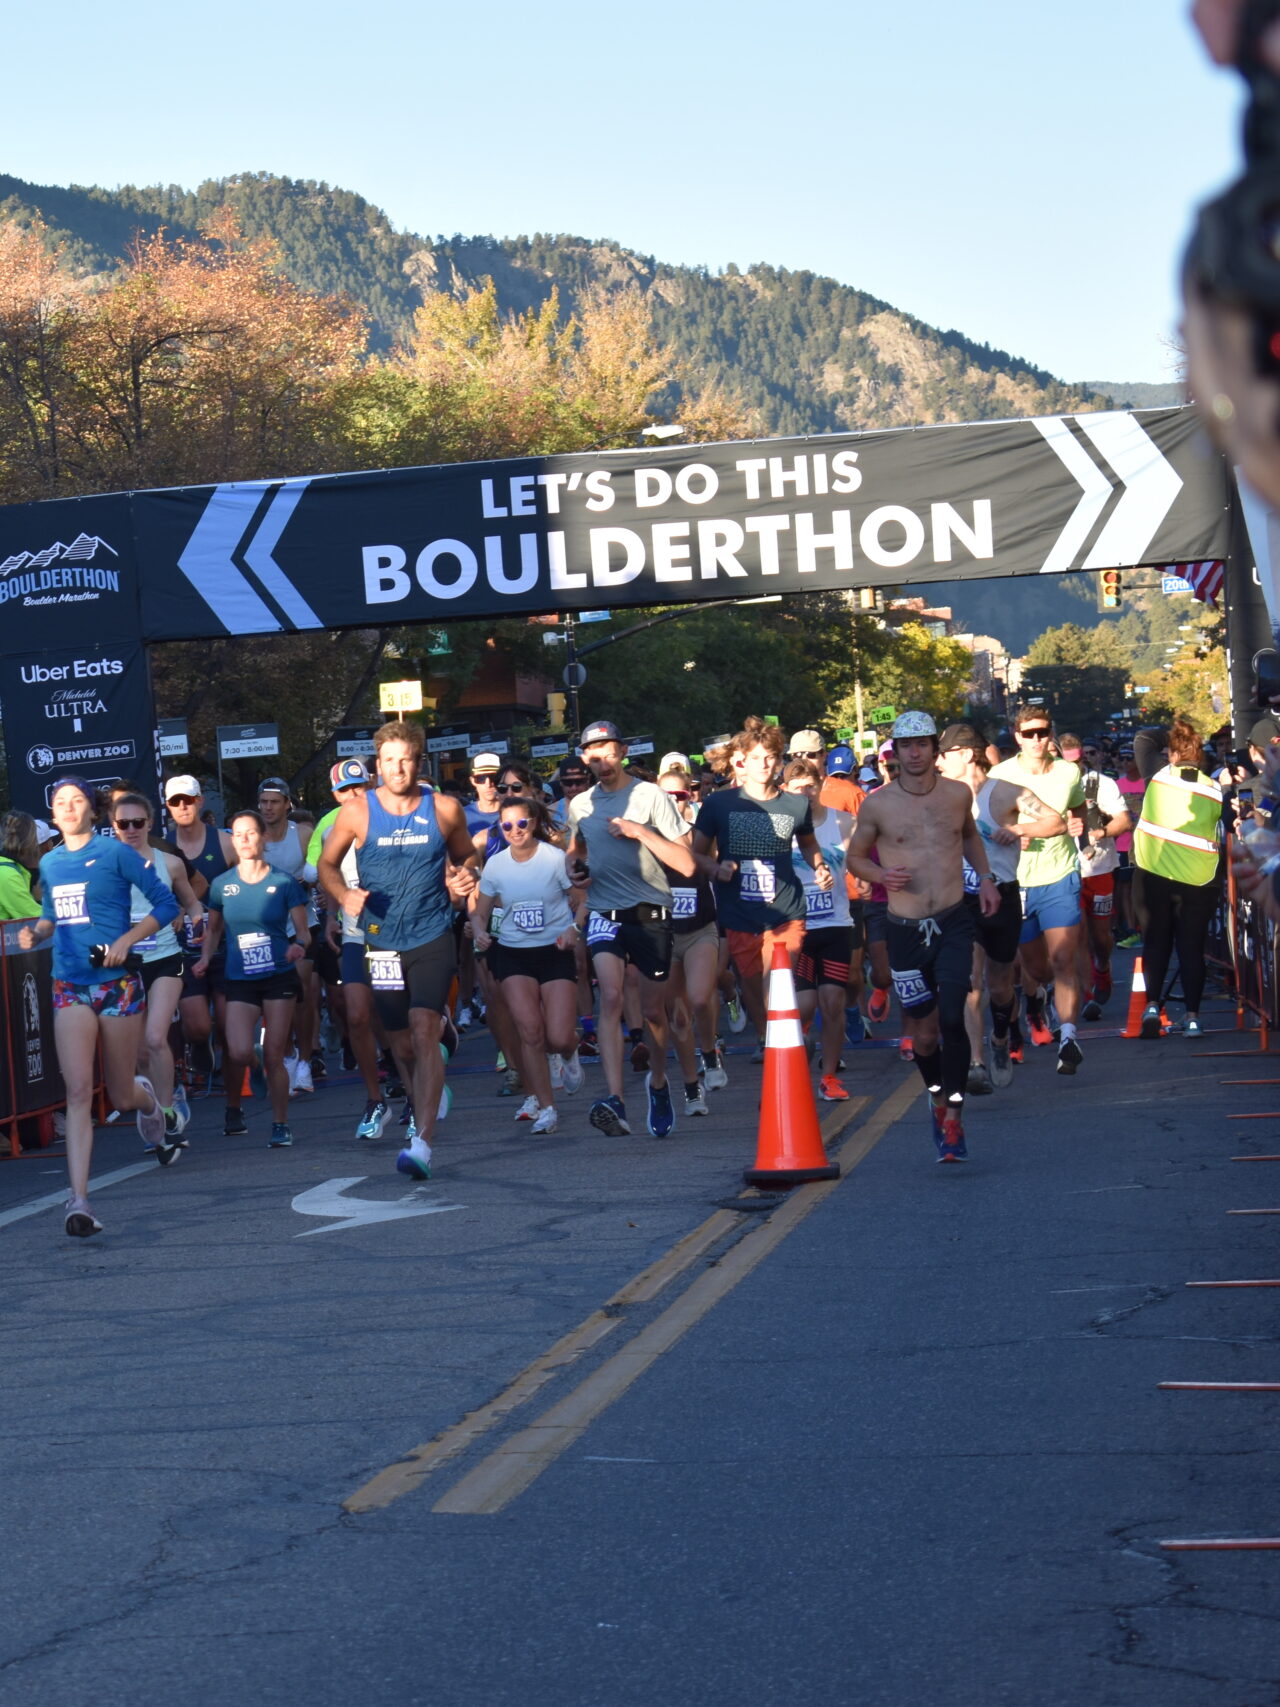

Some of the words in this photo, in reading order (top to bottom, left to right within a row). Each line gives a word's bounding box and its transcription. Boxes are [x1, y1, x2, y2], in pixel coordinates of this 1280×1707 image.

[481, 471, 616, 519] LET'S
[635, 464, 718, 508] DO
[736, 450, 863, 499] THIS
[362, 499, 993, 605] BOULDERTHON
[1164, 580, 1189, 591] 20th
[23, 595, 56, 606] Boulder
[58, 591, 99, 603] Marathon
[21, 665, 69, 684] Uber
[73, 658, 124, 678] Eats
[44, 699, 108, 718] ULTRA
[875, 712, 891, 722] 1:45
[57, 748, 102, 761] DENVER
[104, 744, 131, 756] ZOO
[377, 836, 393, 847] RUN
[393, 834, 429, 846] COLORADO
[741, 874, 774, 892] 4615
[54, 896, 84, 918] 6667
[588, 919, 617, 934] 4487
[241, 946, 272, 965] 5528
[371, 961, 402, 980] 3630
